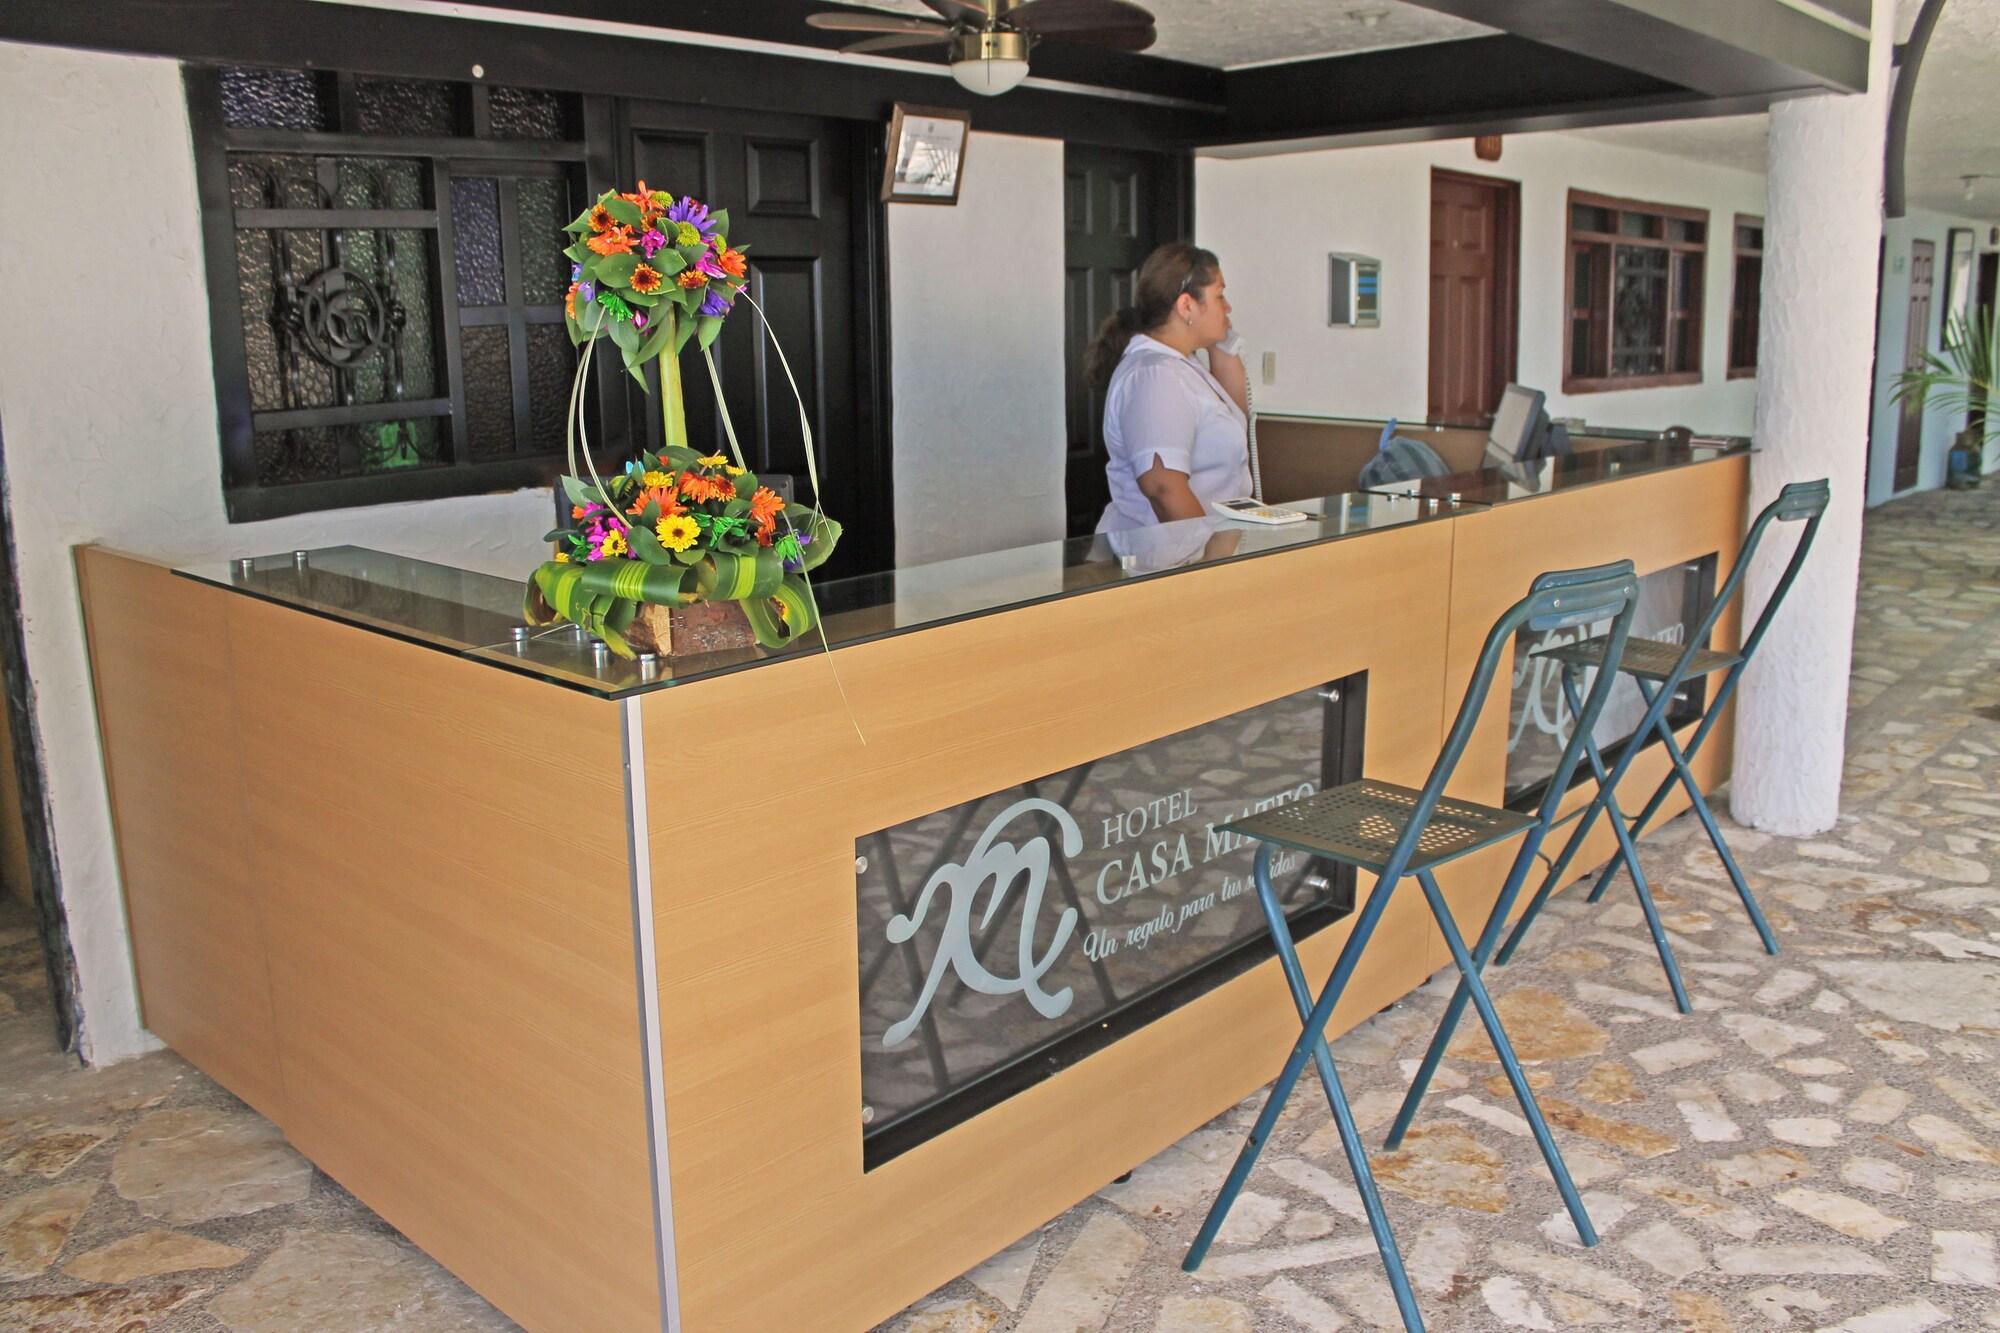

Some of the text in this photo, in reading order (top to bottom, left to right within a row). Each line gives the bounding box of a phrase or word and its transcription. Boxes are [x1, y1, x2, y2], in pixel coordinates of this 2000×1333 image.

[1101, 788, 1198, 850] HOTEL
[1096, 832, 1194, 905] CASA
[1083, 851, 1297, 962] Un regalo para tus seidos
